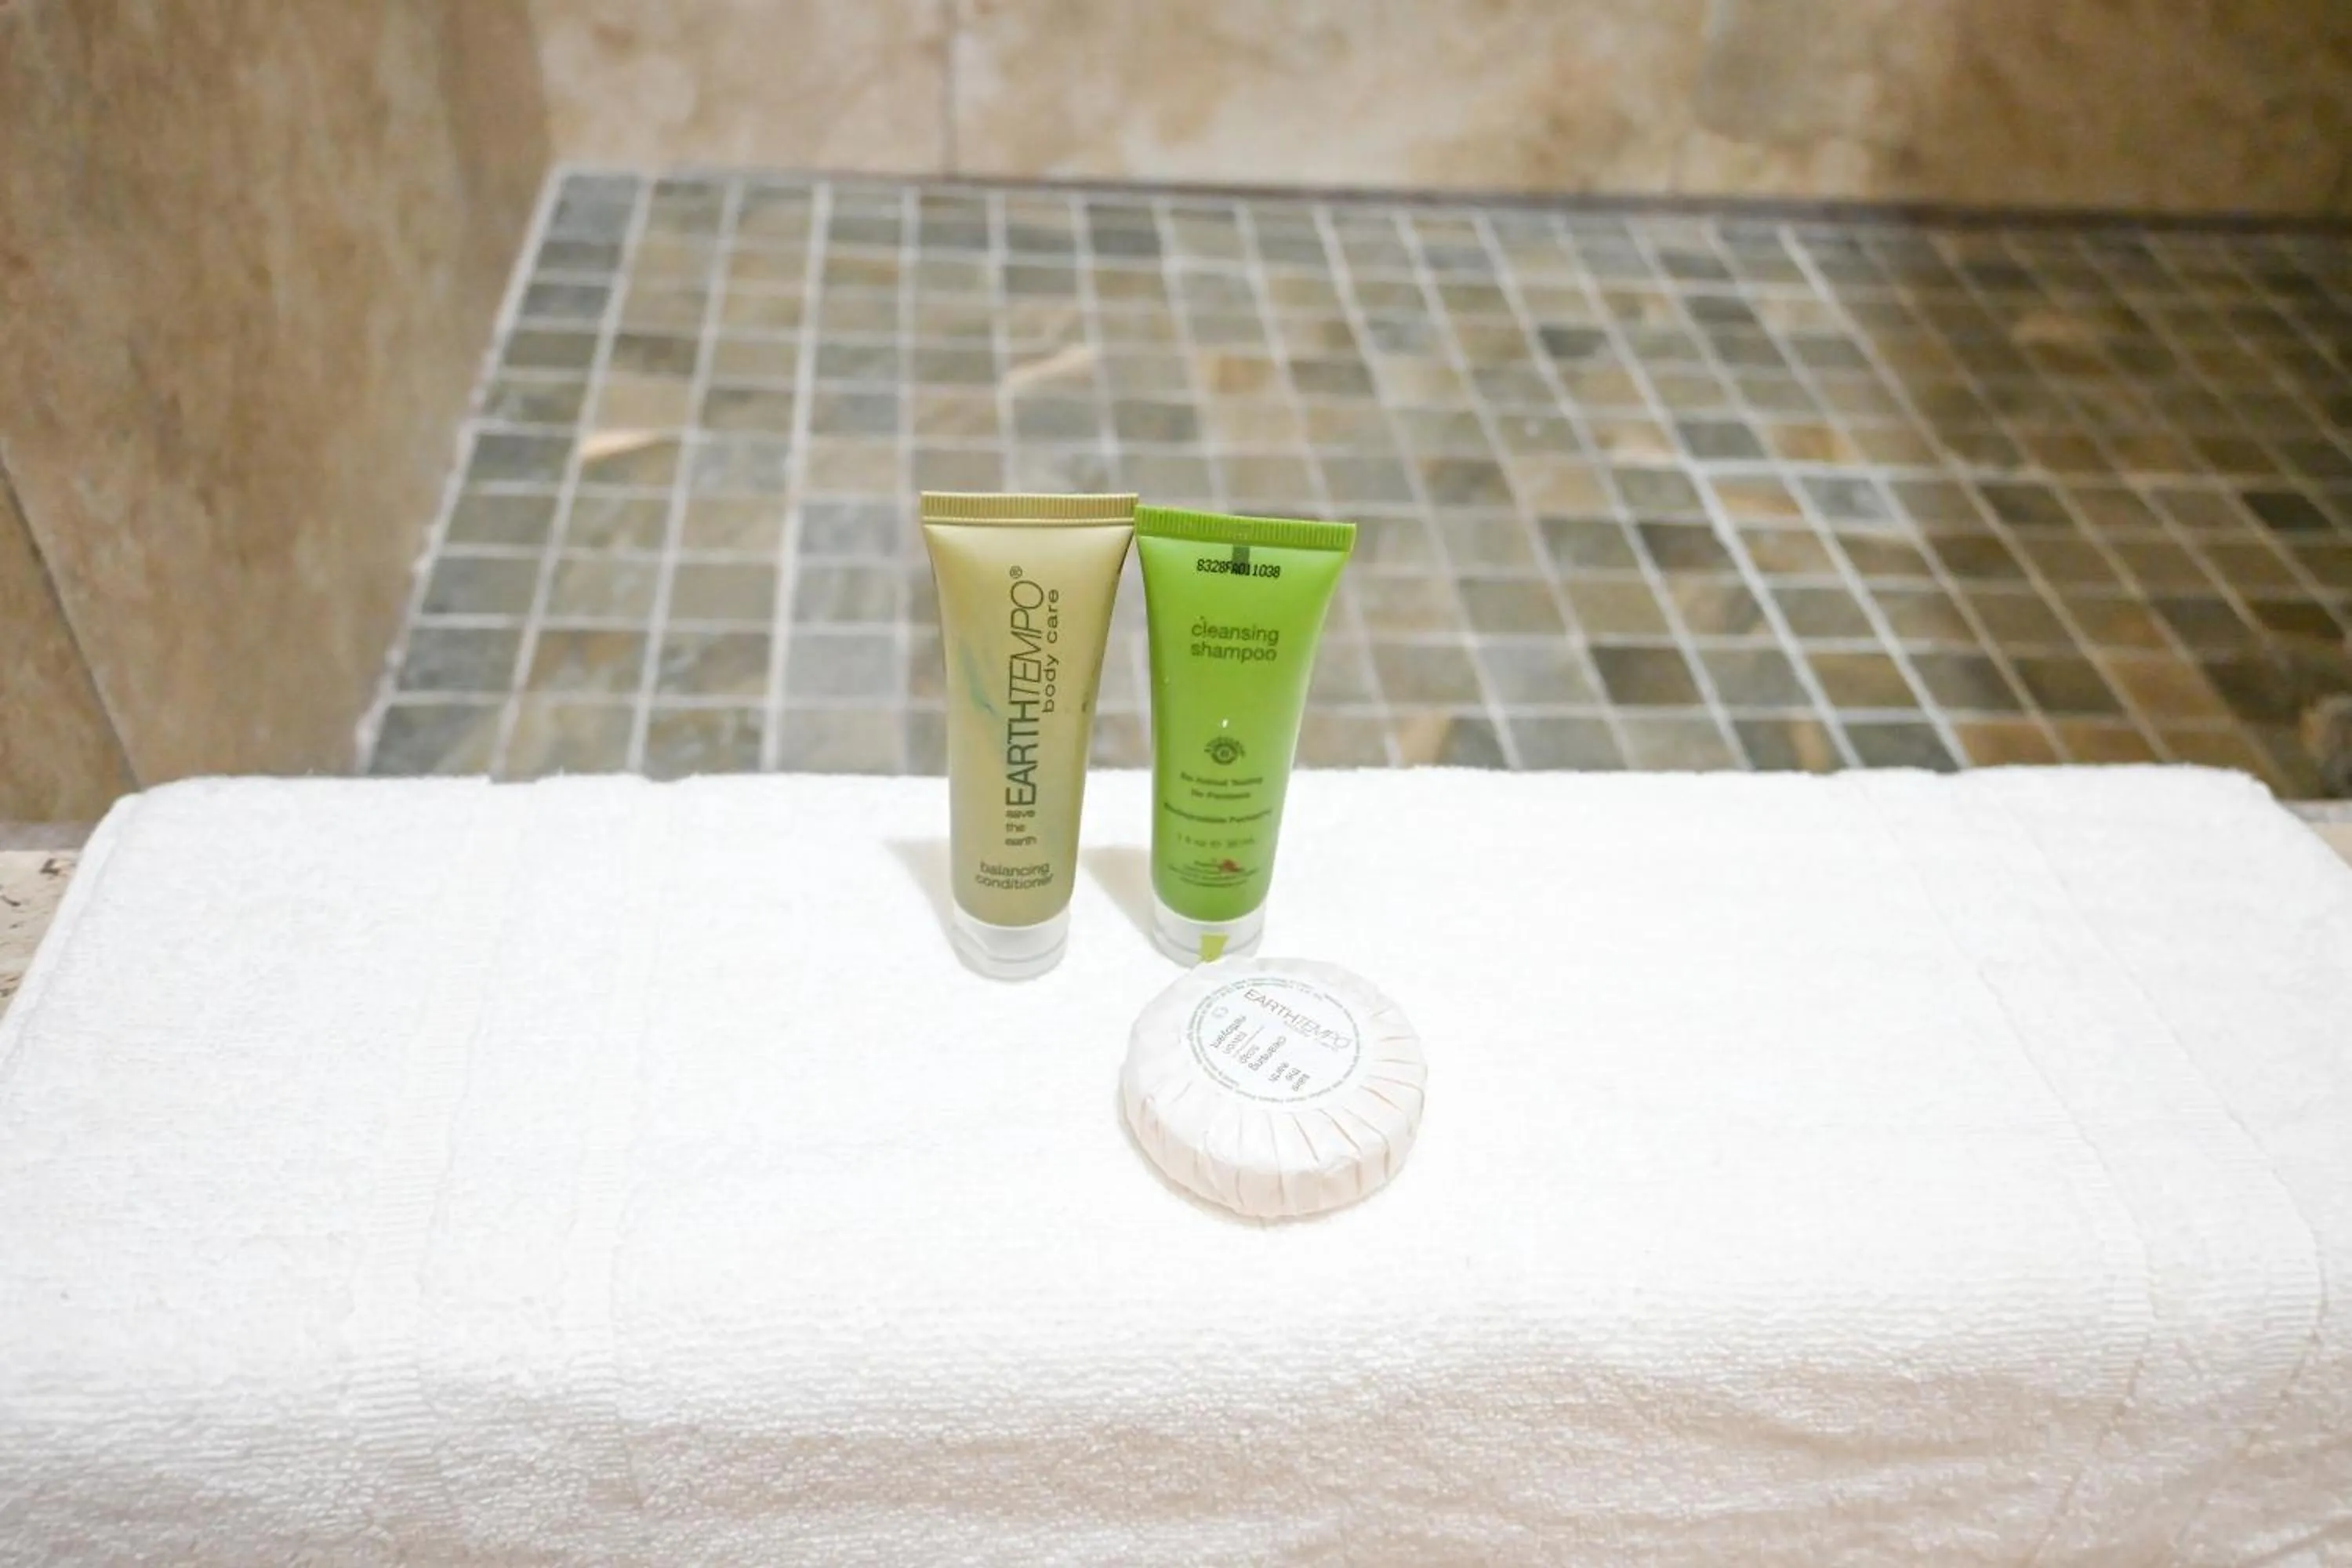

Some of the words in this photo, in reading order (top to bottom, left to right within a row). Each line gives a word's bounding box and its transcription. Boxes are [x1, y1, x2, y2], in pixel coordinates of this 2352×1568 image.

[1047, 589, 1059, 644] care
[1191, 620, 1279, 646] cleansing
[1190, 641, 1277, 663] shampoo
[1042, 654, 1059, 713] body
[980, 860, 1050, 877] balancing
[975, 873, 1054, 890] conditioner
